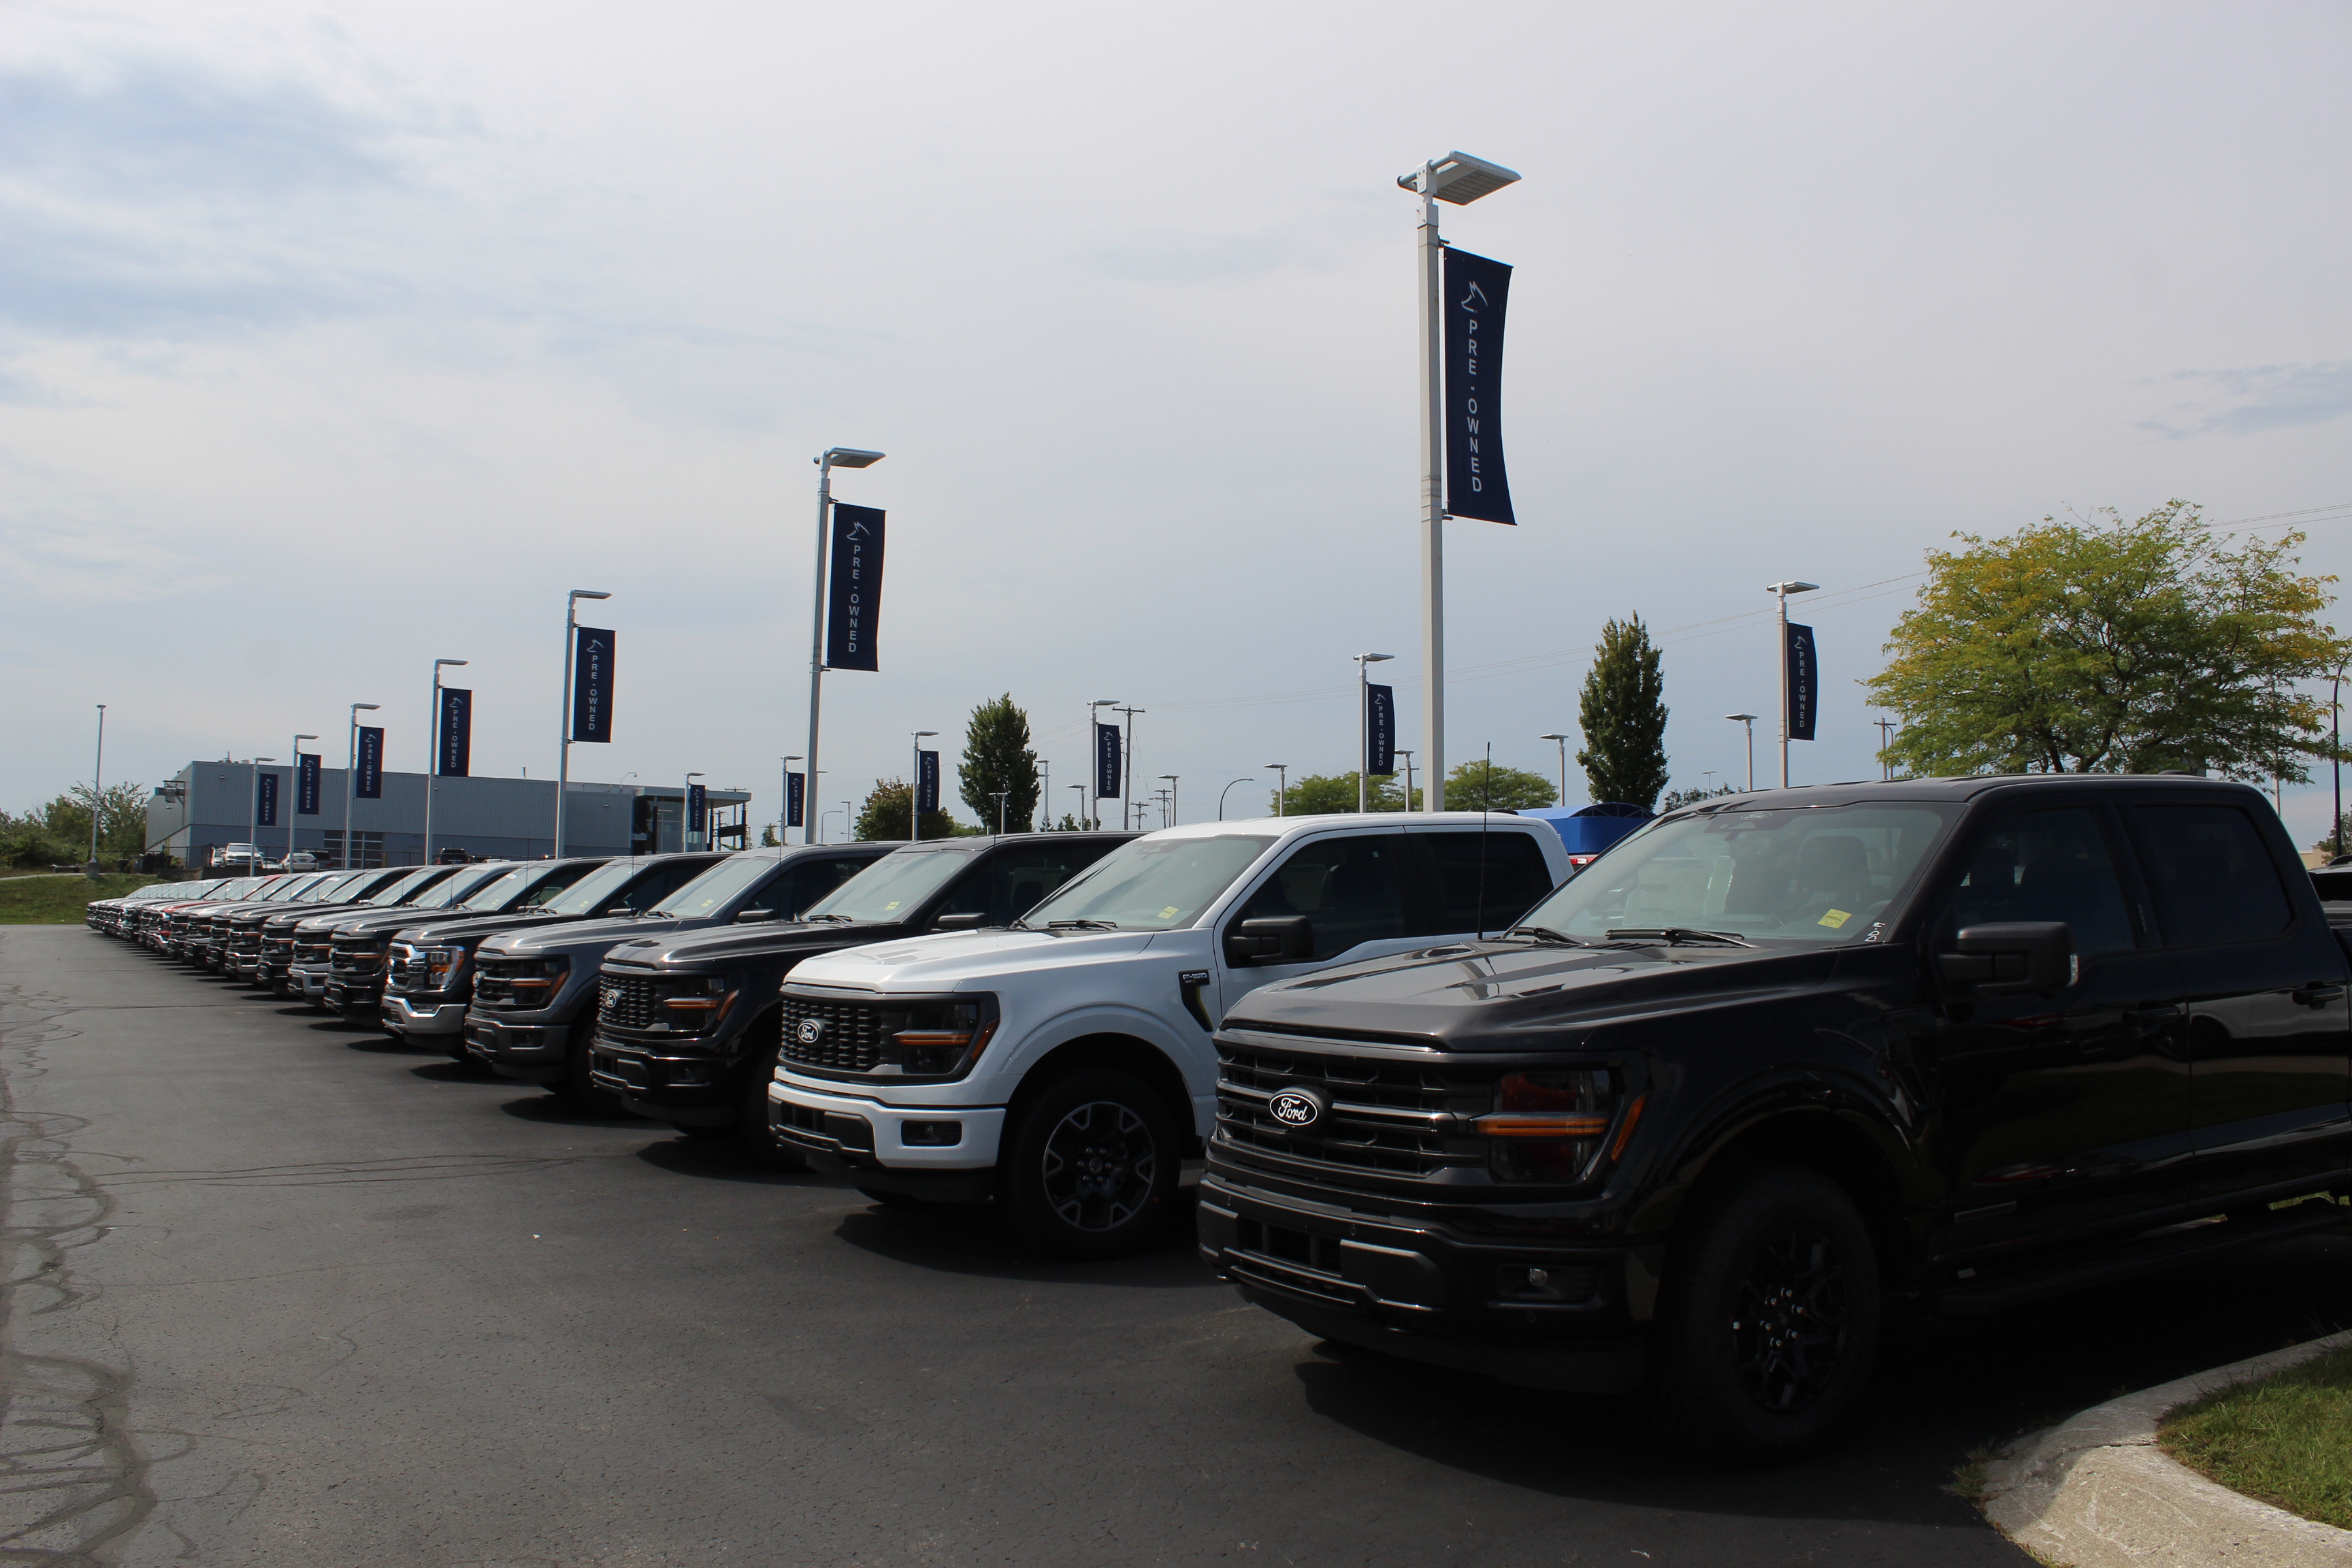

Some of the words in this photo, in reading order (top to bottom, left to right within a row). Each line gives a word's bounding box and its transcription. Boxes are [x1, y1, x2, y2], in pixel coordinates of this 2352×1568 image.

[1467, 319, 1482, 492] PRE-OWNED
[849, 545, 861, 653] PRE-OWNED
[589, 655, 598, 730] PRE-OWNED
[801, 1025, 815, 1040] Ford
[1278, 1097, 1308, 1122] Ford
